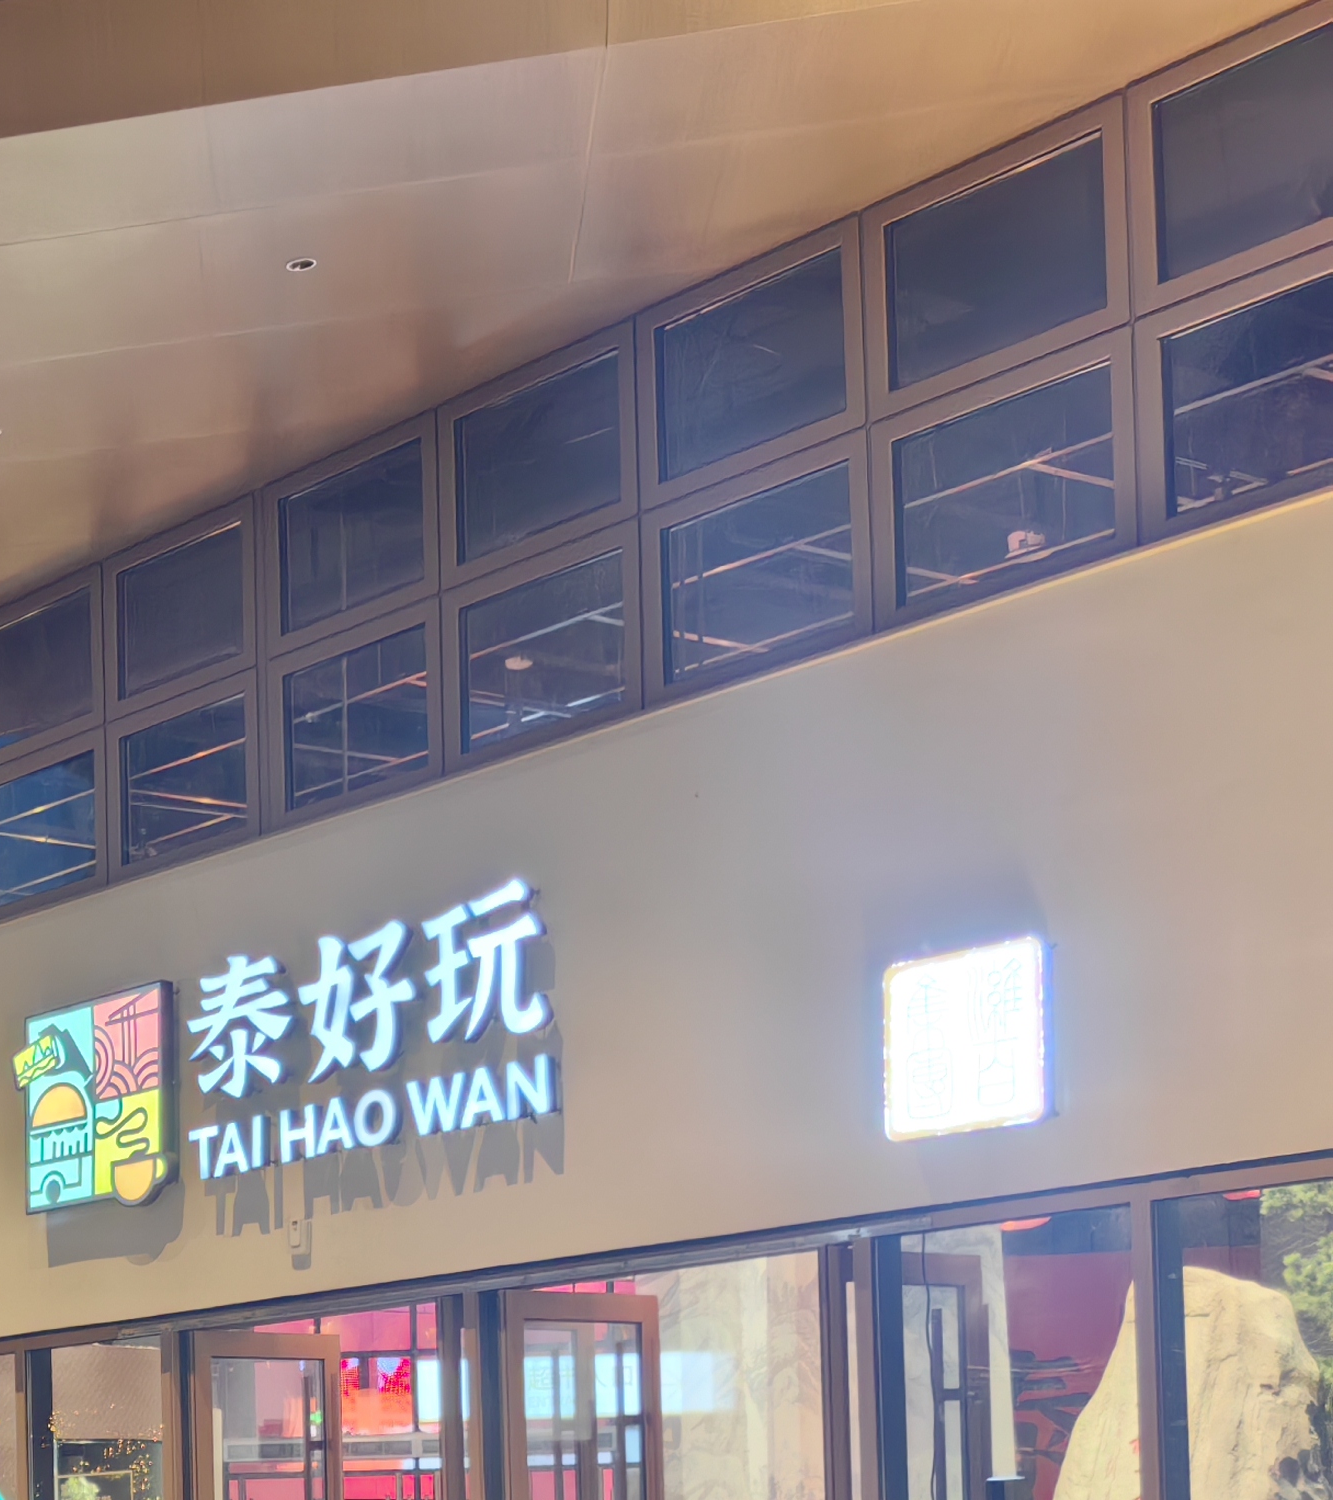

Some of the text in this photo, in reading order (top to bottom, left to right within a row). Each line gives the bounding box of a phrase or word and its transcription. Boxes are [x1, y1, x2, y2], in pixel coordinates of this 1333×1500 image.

[187, 878, 551, 1099] 泰好玩
[188, 1053, 555, 1181] TAI HAO WAN
